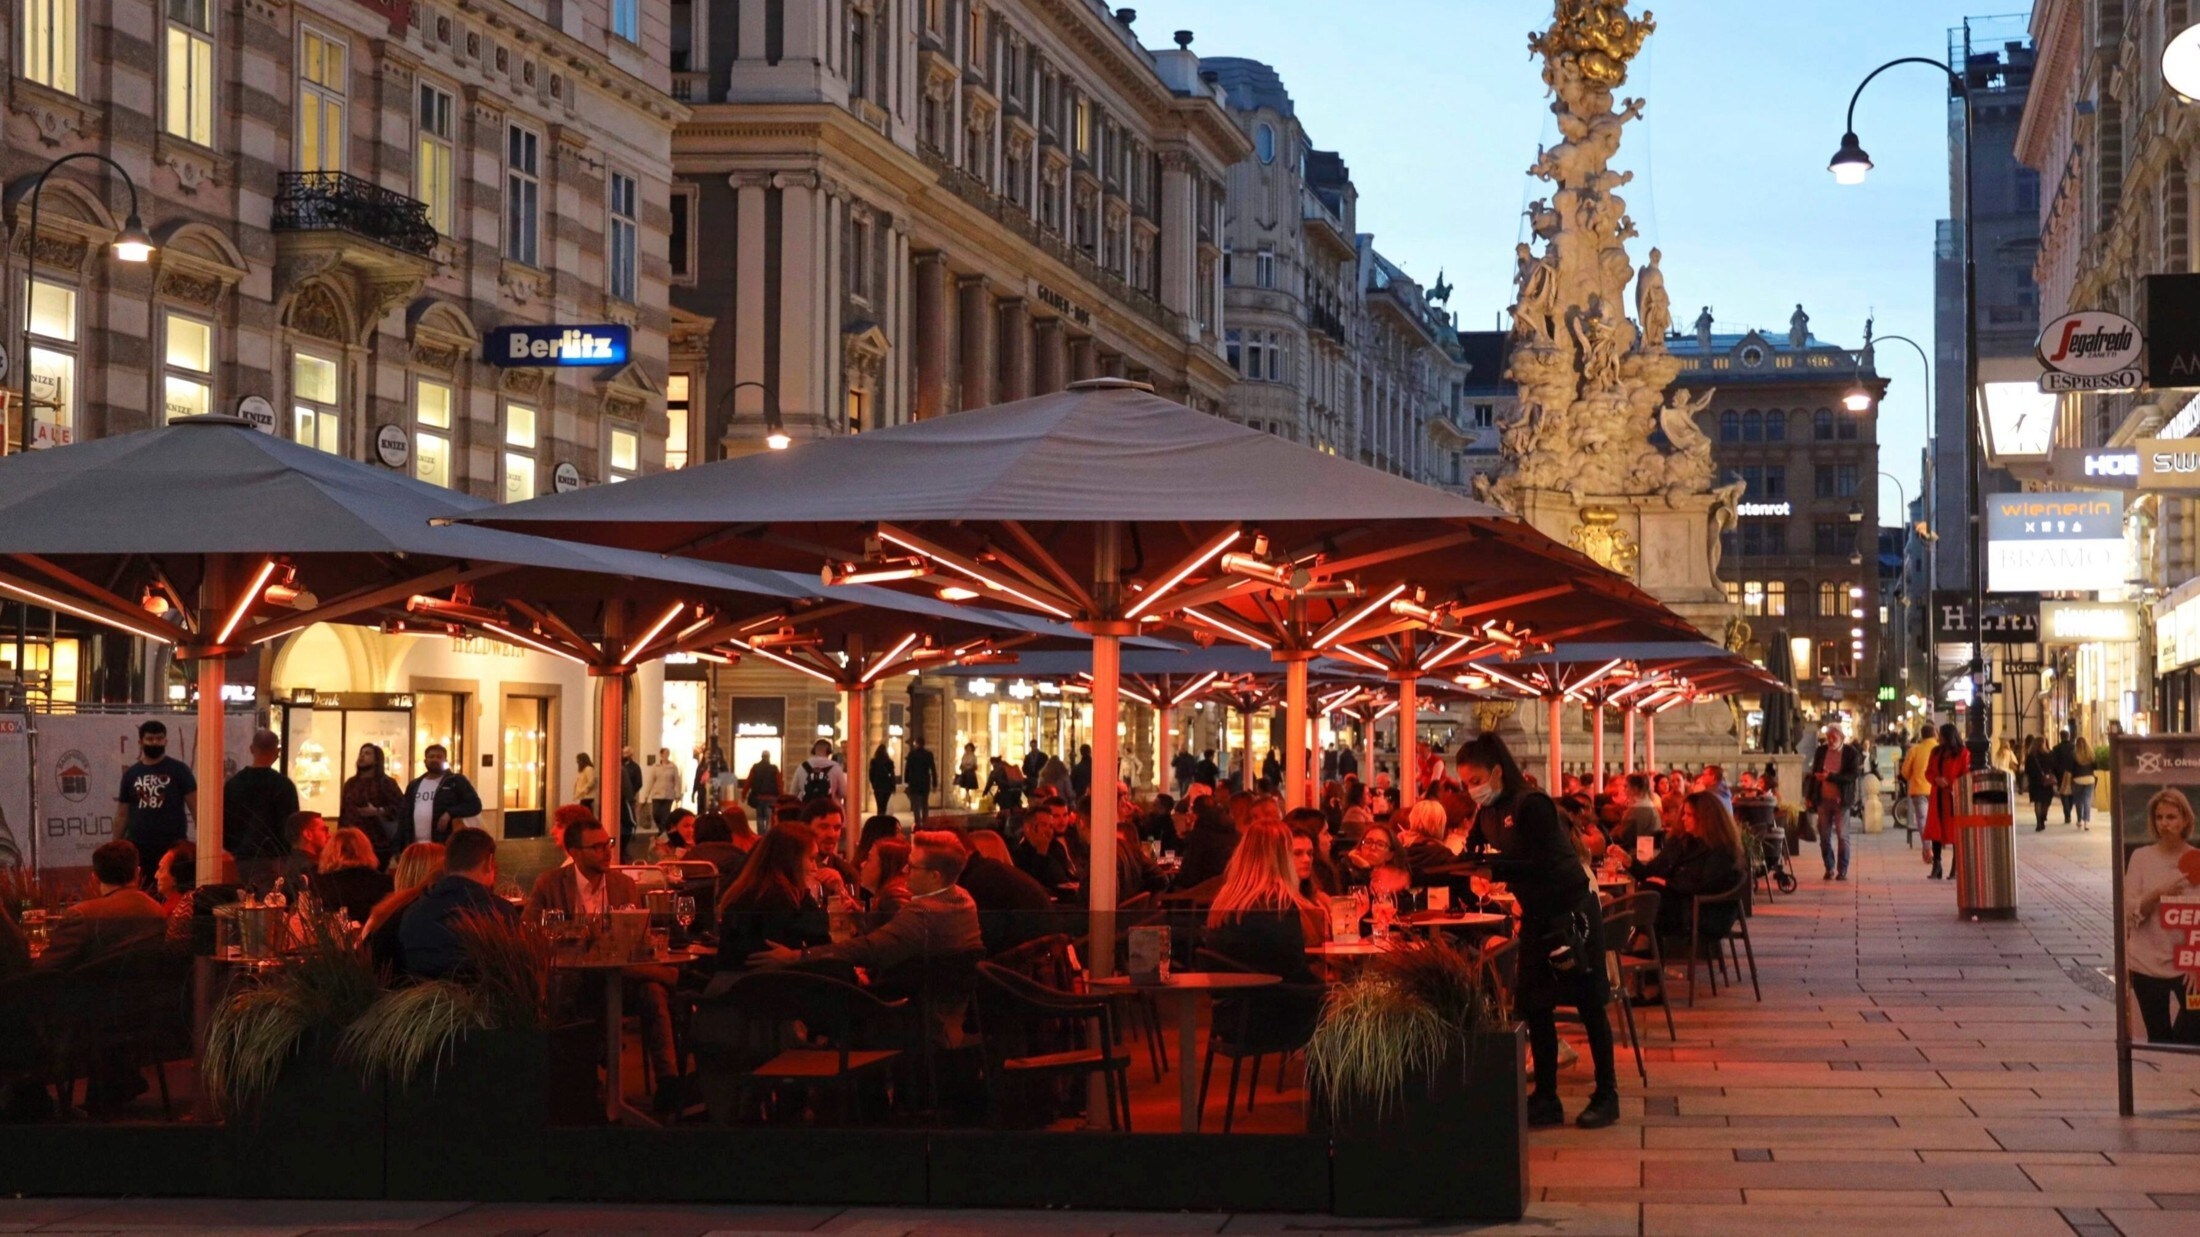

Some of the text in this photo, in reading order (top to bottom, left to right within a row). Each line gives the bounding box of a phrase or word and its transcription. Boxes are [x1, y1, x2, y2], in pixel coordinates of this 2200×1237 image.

[509, 329, 612, 358] Berlitz
[2050, 320, 2133, 361] Segafredo
[2050, 371, 2135, 389] ESPRESSO
[242, 410, 272, 425] KNIZE
[381, 439, 406, 451] KNIZE
[2153, 452, 2200, 473] SW
[1737, 502, 1790, 516] stenrot
[2001, 501, 2111, 517] wienerin
[2005, 663, 2040, 673] ESCADA
